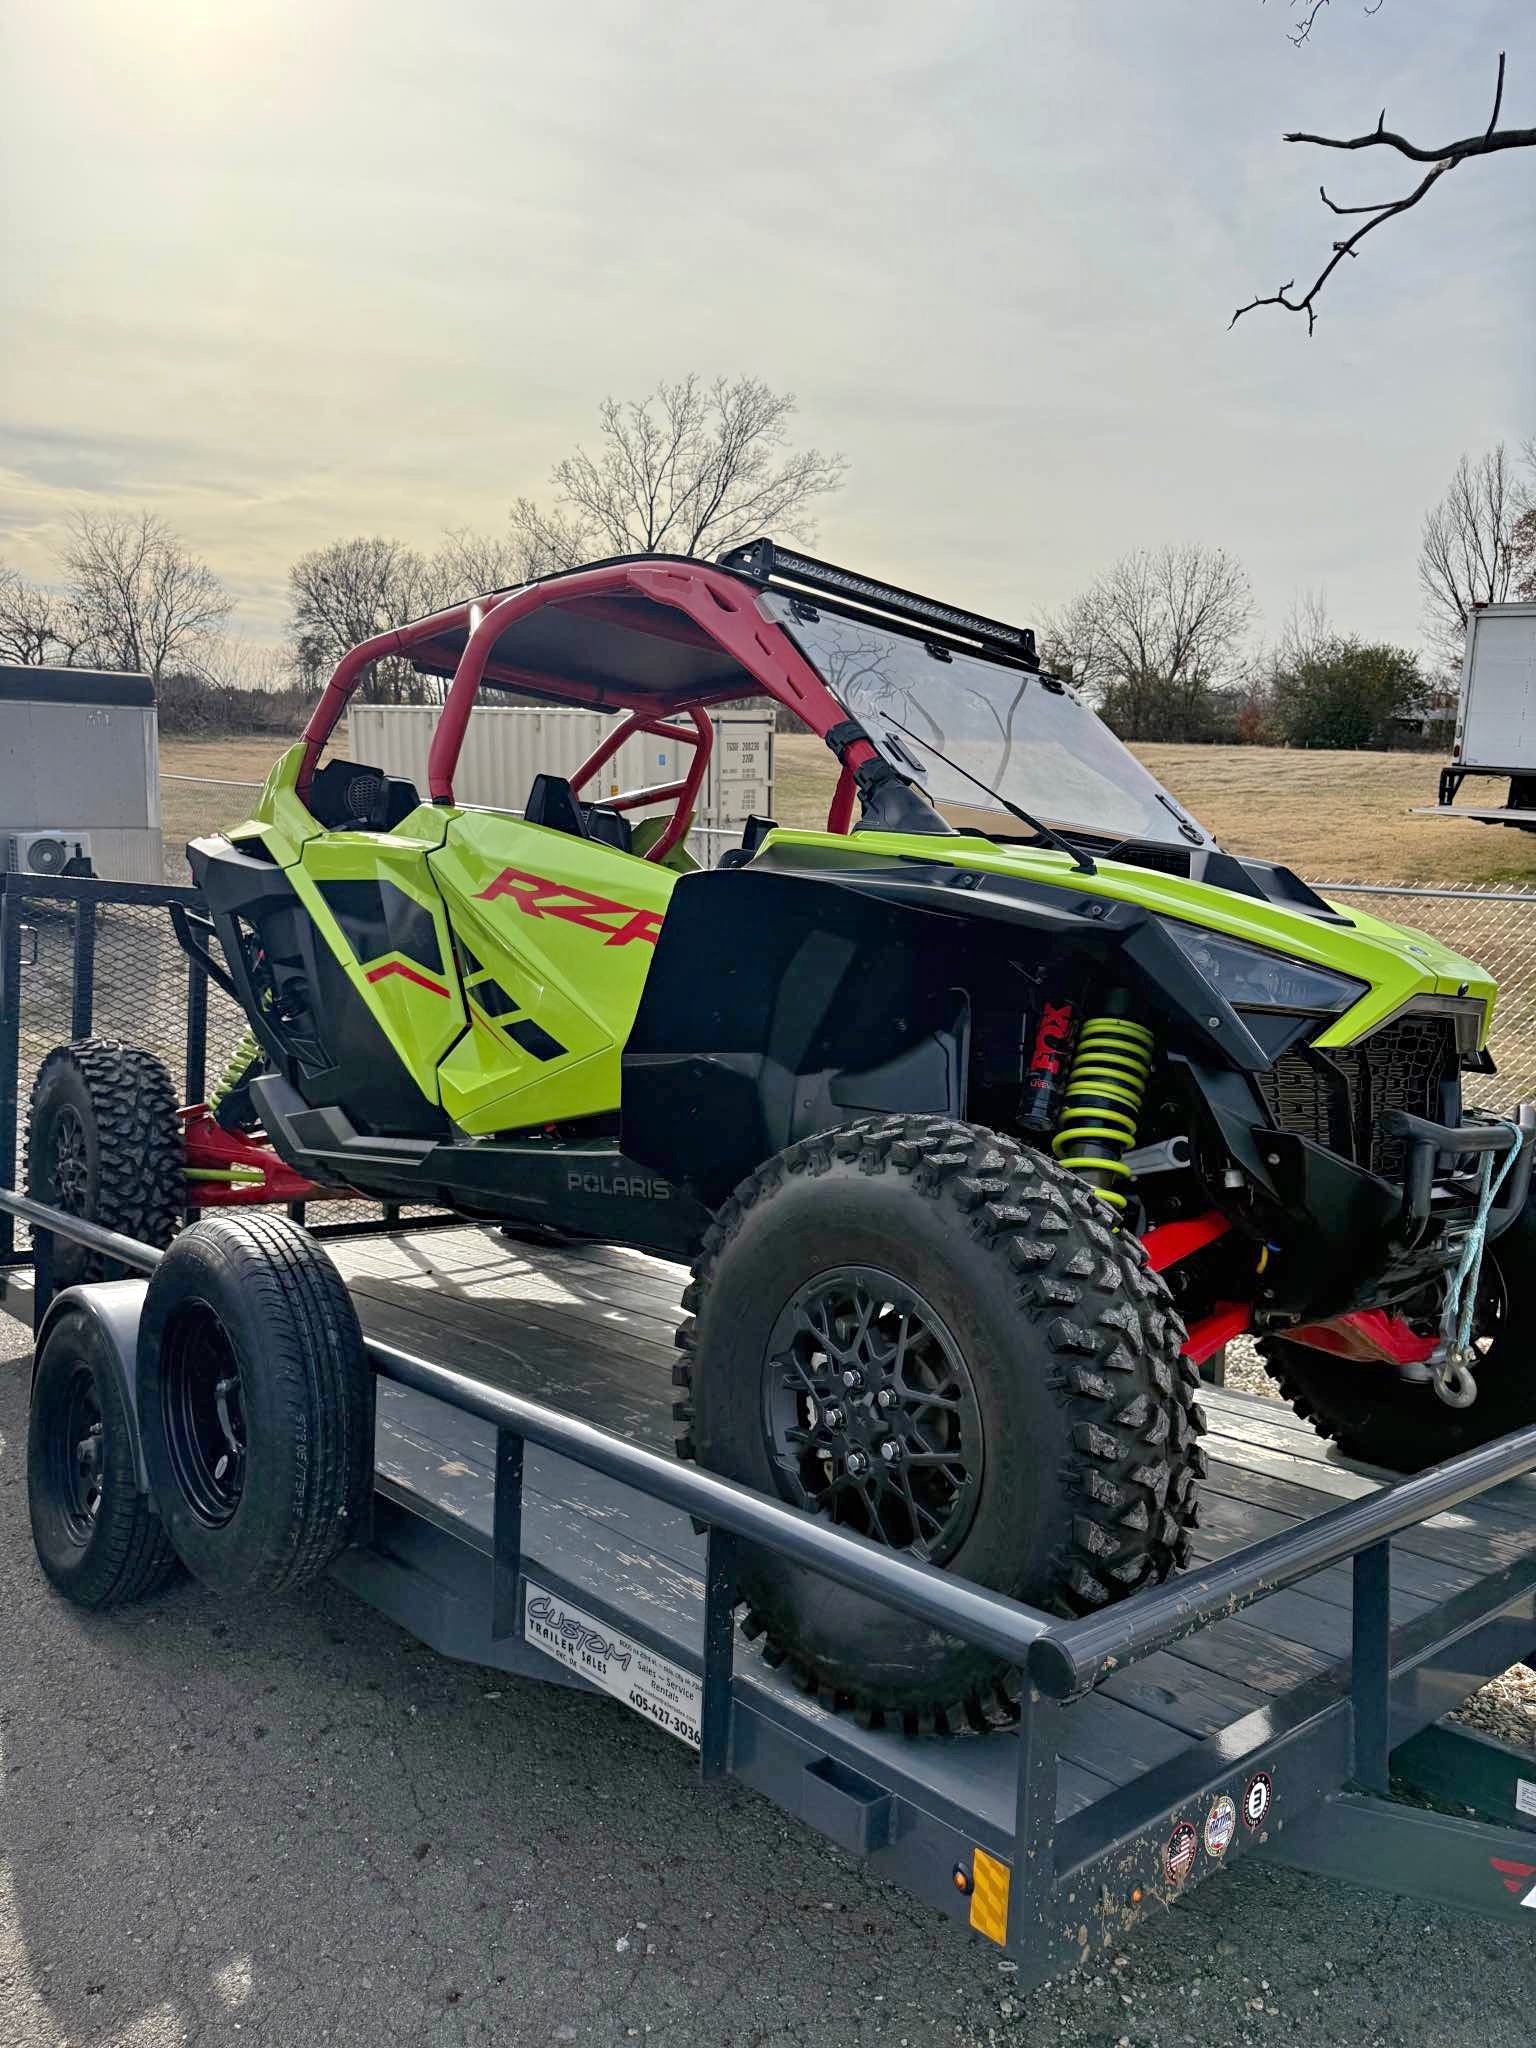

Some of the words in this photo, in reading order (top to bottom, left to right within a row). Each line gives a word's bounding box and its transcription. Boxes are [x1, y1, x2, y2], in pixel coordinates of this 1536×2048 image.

[1030, 1001, 1072, 1075] FOX
[567, 1170, 671, 1200] POLARIS
[528, 1597, 632, 1672] CUSTOM
[529, 1619, 574, 1656] TRAILER
[582, 1651, 606, 1674] SALES
[637, 1661, 656, 1679] Sales
[666, 1678, 694, 1701] Service
[651, 1680, 679, 1703] Rentals
[629, 1690, 701, 1745] 405-427-3036
